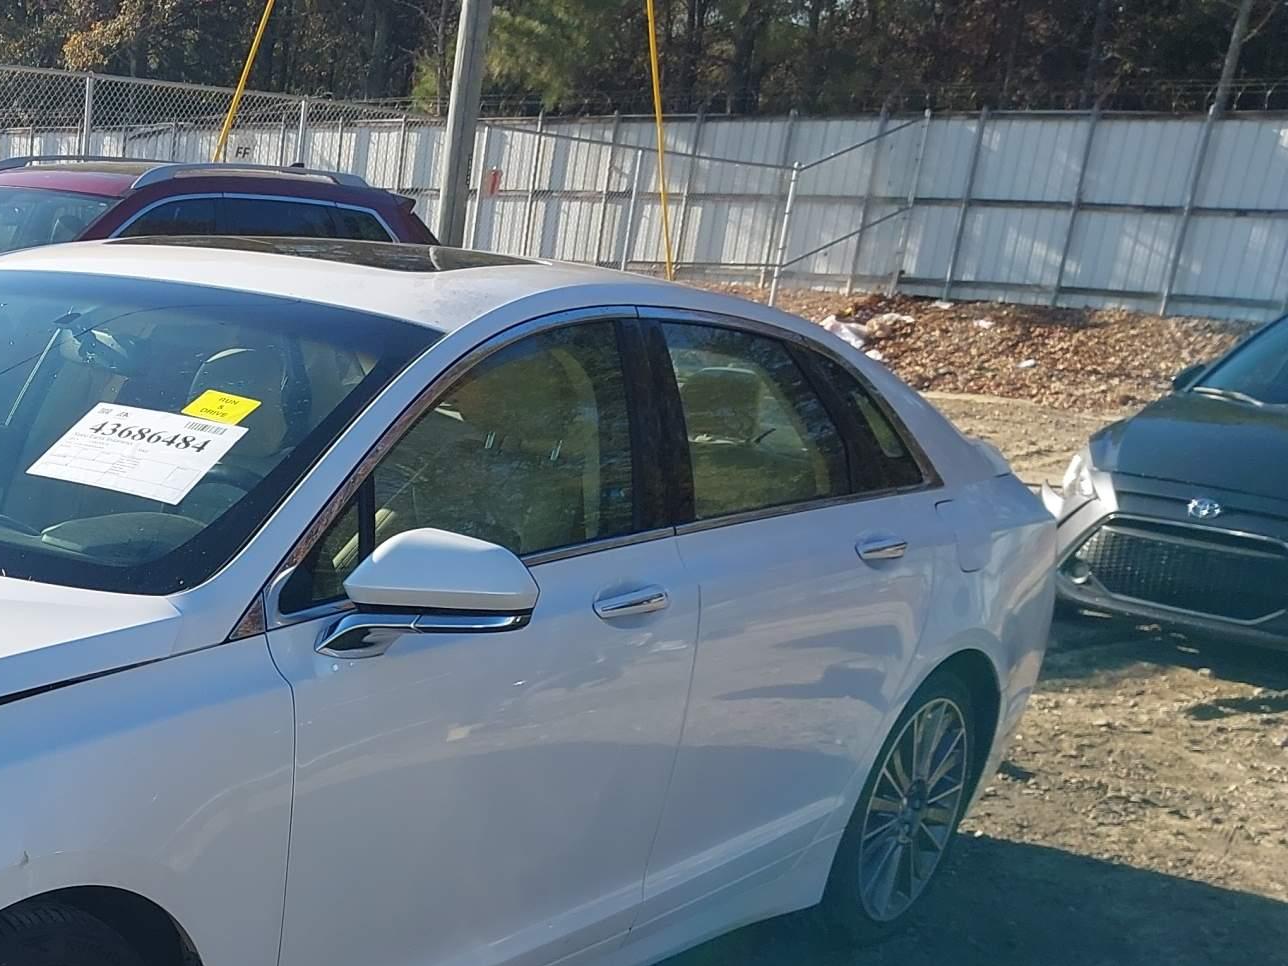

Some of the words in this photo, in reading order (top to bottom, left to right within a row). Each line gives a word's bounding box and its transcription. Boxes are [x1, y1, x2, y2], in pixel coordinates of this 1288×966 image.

[235, 146, 251, 159] FF
[218, 397, 240, 405] RUN
[199, 407, 229, 418] DRIVE
[89, 420, 212, 453] 43686484
